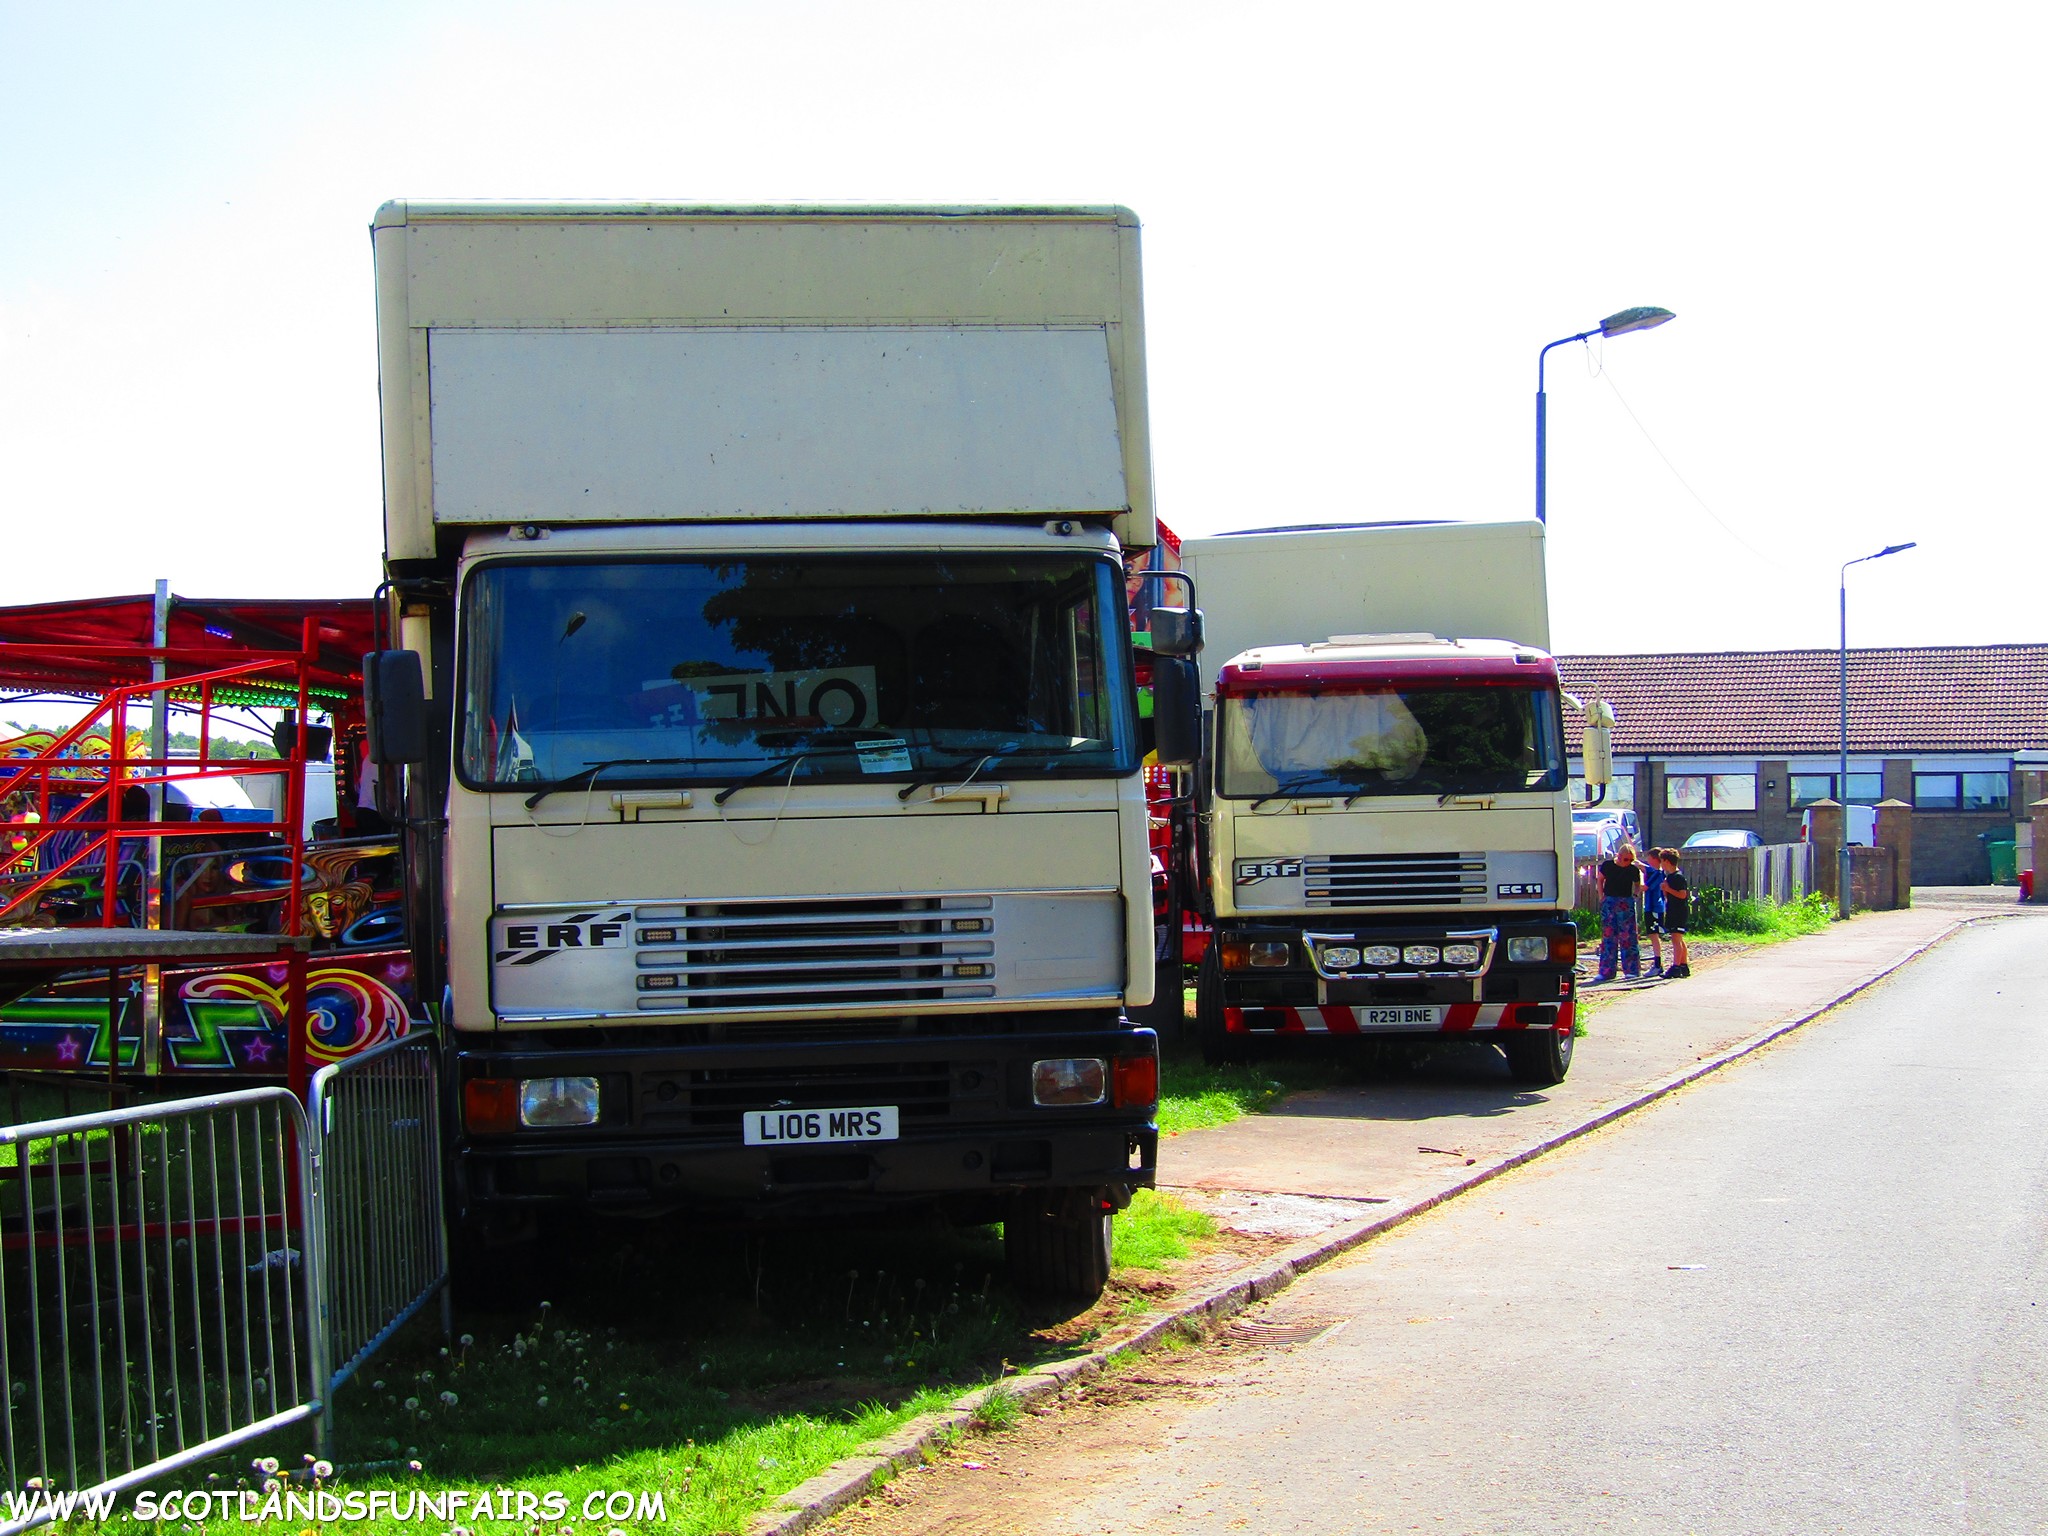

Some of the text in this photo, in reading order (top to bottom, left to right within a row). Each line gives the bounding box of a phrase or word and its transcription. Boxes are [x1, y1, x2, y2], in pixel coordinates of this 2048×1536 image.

[1241, 864, 1298, 877] ERF
[1499, 884, 1541, 894] EC 11
[507, 923, 622, 949] ERF
[1369, 1009, 1432, 1023] R291 BNE
[760, 1111, 882, 1140] L106 MRS
